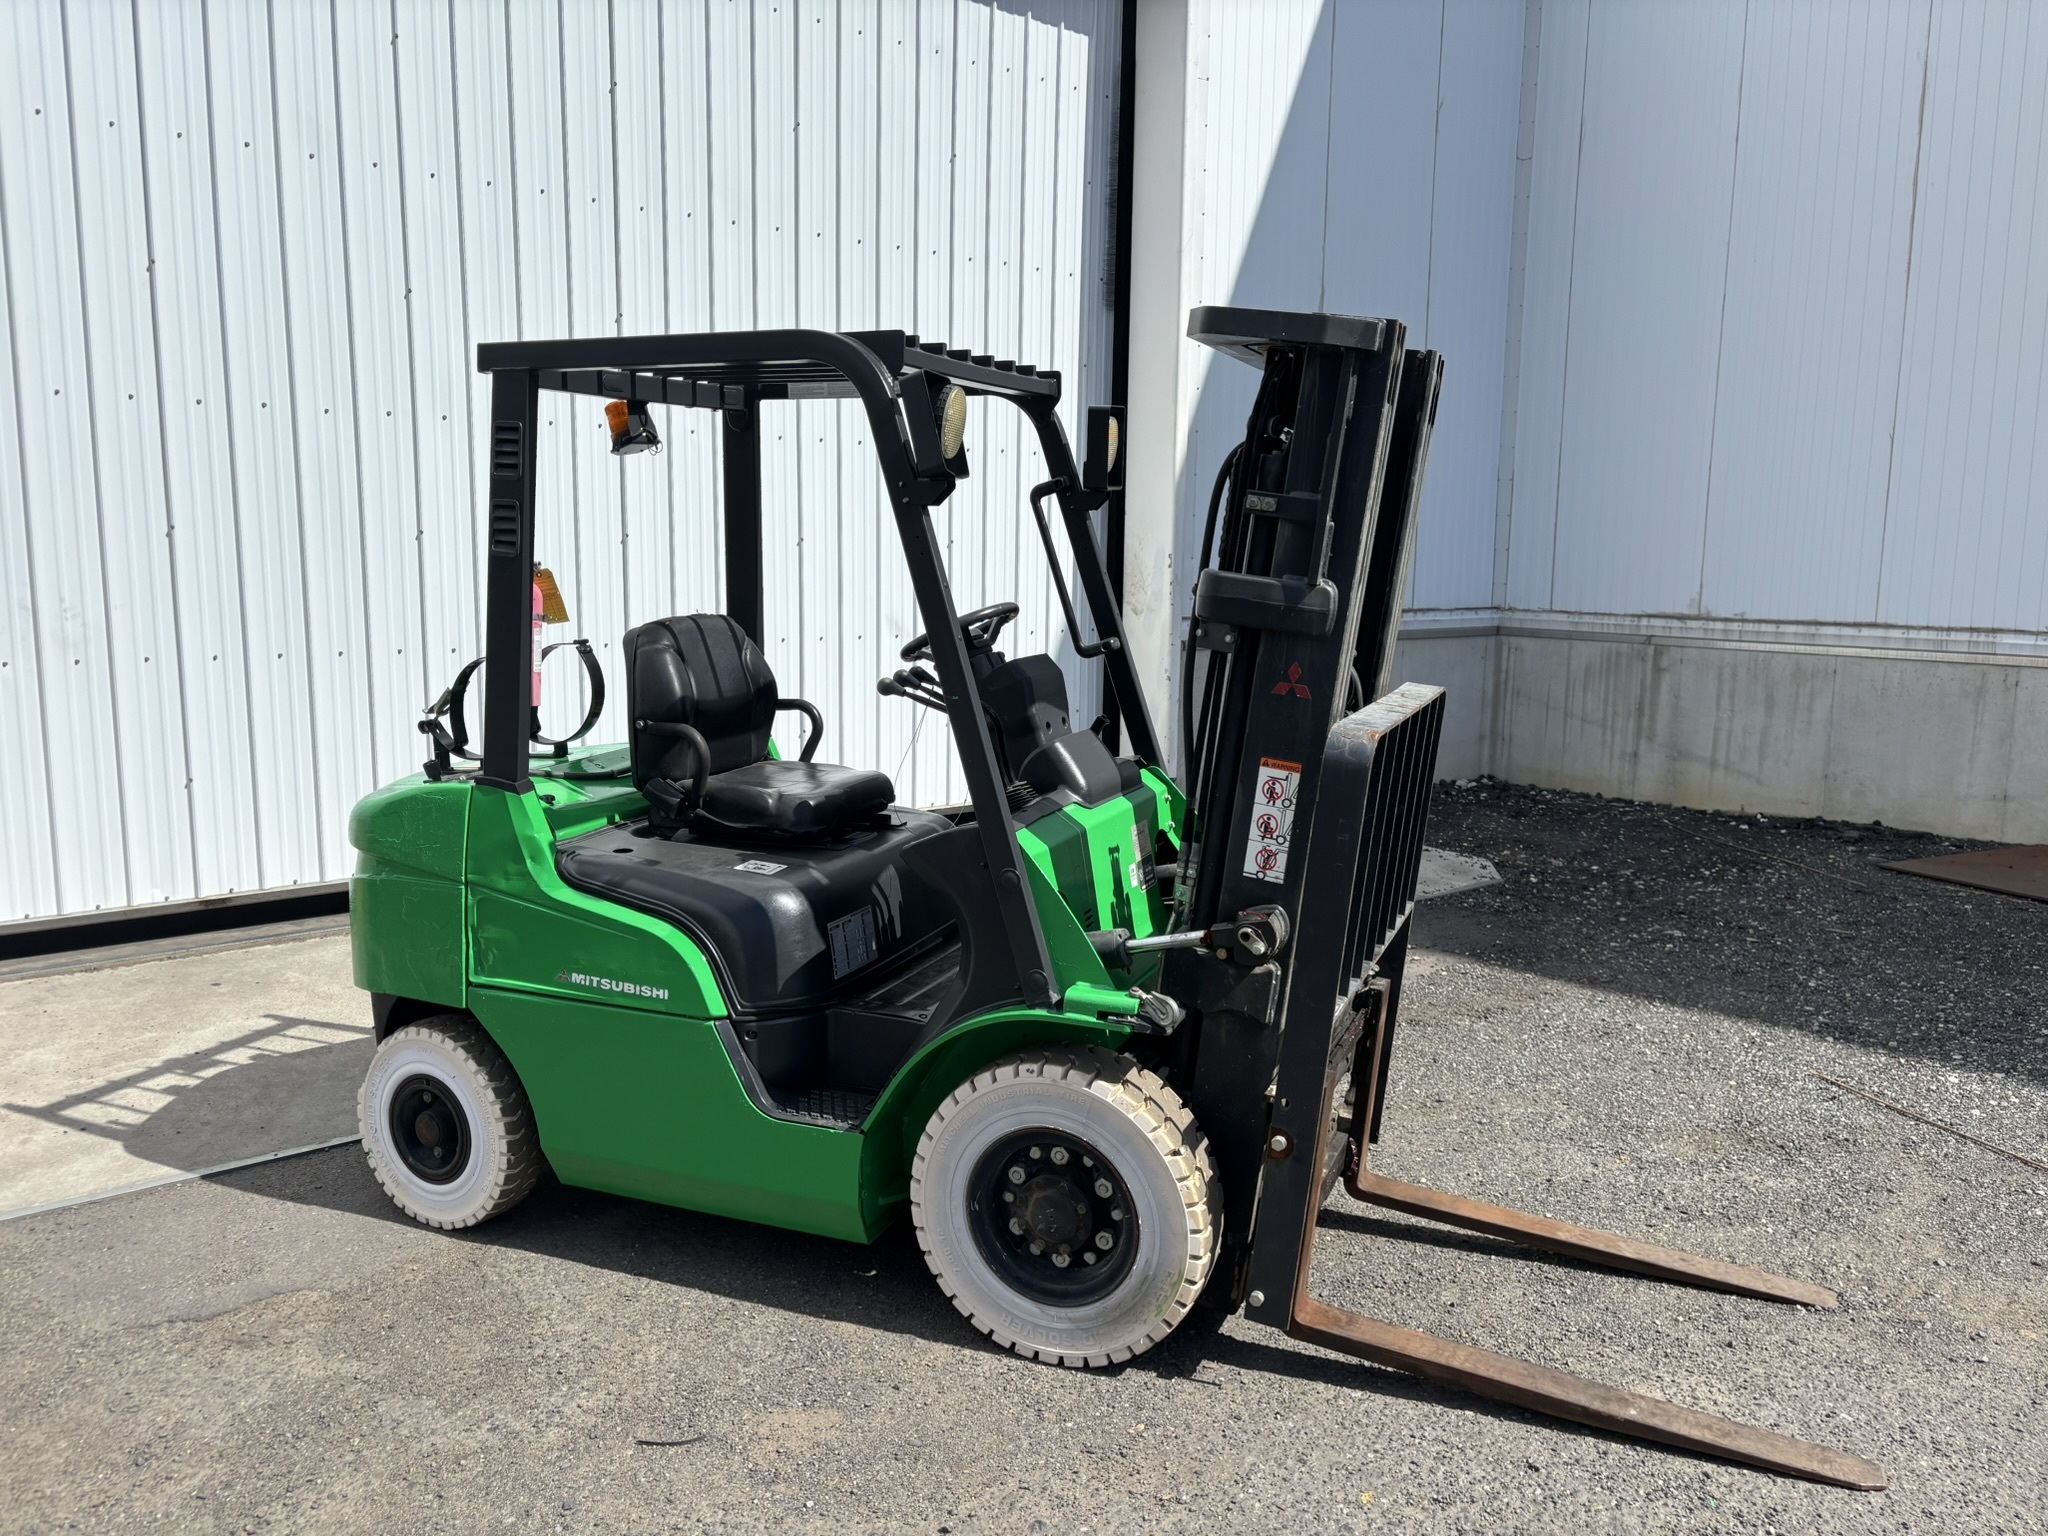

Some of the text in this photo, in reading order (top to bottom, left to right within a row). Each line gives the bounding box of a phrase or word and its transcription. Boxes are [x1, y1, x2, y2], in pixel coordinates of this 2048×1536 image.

[1270, 762, 1300, 773] WARNING
[571, 972, 669, 1000] MITSUBISHI
[369, 1056, 392, 1098] SOLVER
[367, 1104, 378, 1142] SOLID
[938, 1109, 977, 1155] MITCHELL
[979, 1087, 1051, 1108] INDUSTRIAL
[1058, 1090, 1086, 1106] TIRE
[999, 1312, 1074, 1348] SOLVER
